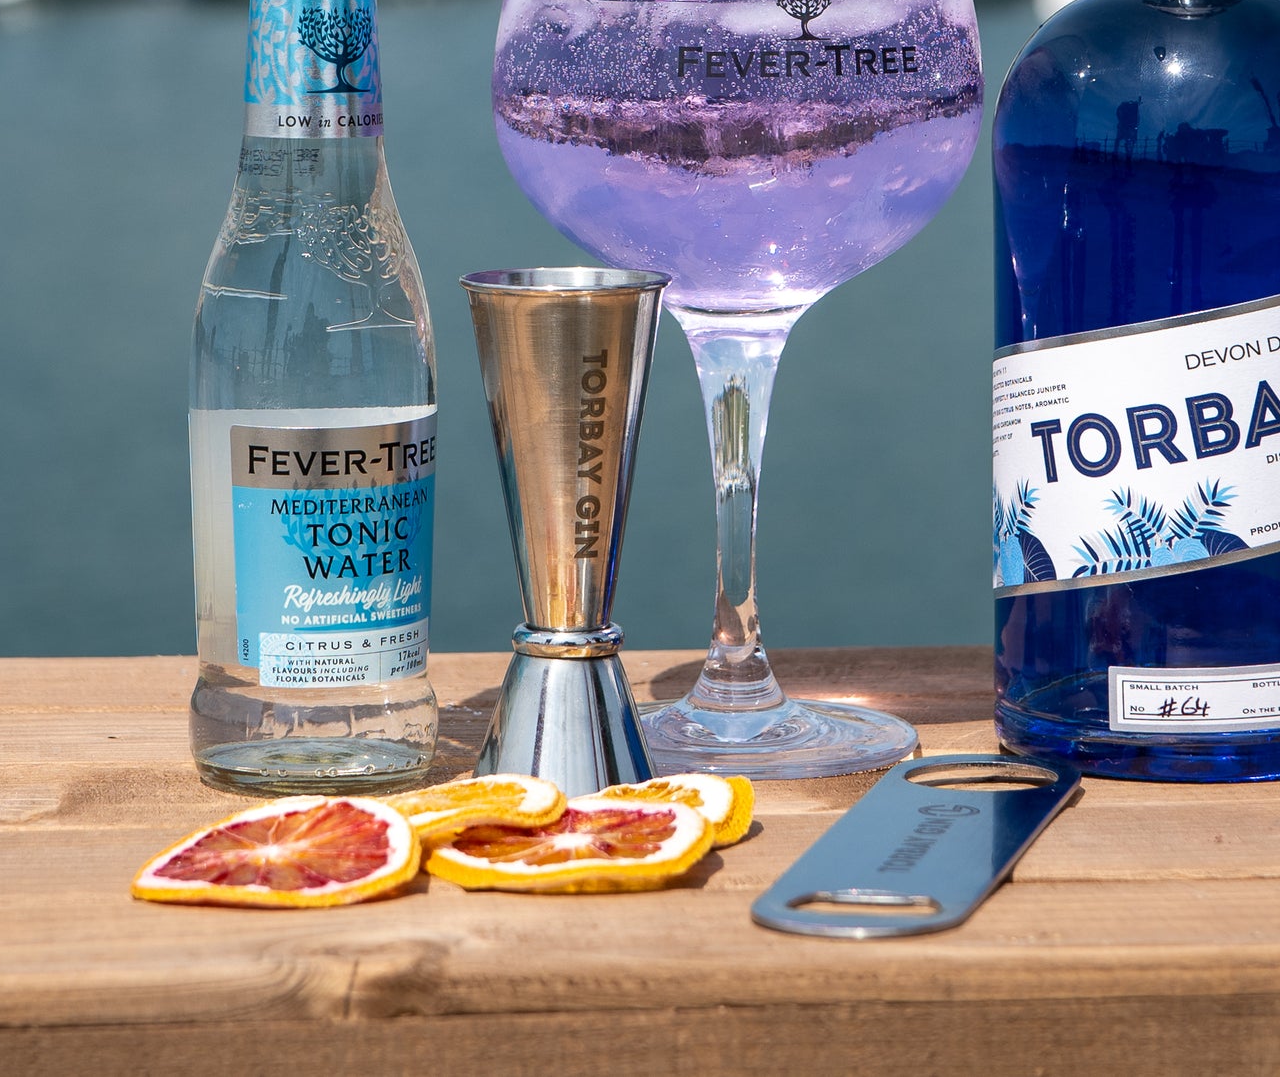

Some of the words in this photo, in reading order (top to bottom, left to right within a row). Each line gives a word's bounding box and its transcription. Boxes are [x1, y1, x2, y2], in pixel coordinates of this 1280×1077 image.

[677, 44, 918, 78] FEVER-TREE
[278, 115, 312, 127] LOW
[319, 115, 331, 127] in
[1185, 340, 1261, 370] DEVON
[1010, 389, 1035, 400] BALANCED
[1037, 384, 1067, 394] JUNIPER
[1035, 397, 1070, 407] AROMATIC
[577, 349, 608, 485] TORBAY
[248, 436, 436, 476] FEVER-TREE
[271, 487, 428, 515] MEDITERRANEAN
[307, 517, 408, 547] TONIC
[574, 495, 601, 559] GIN
[303, 549, 411, 579] WATER
[284, 582, 392, 612] Refreshingly
[393, 575, 422, 604] Light
[281, 615, 299, 625] NO
[304, 614, 367, 625] ARTIFICIAL
[371, 603, 421, 621] SWEETENERS
[285, 640, 352, 651] CITRUS
[362, 639, 371, 648] &
[381, 629, 419, 646] FRESH
[315, 658, 354, 666] NATURAL
[398, 647, 421, 662] 17kcal
[276, 675, 308, 683] FLORAL
[312, 674, 366, 683] BOTANICALS
[320, 665, 369, 674] INCLUDING
[391, 665, 405, 676] per
